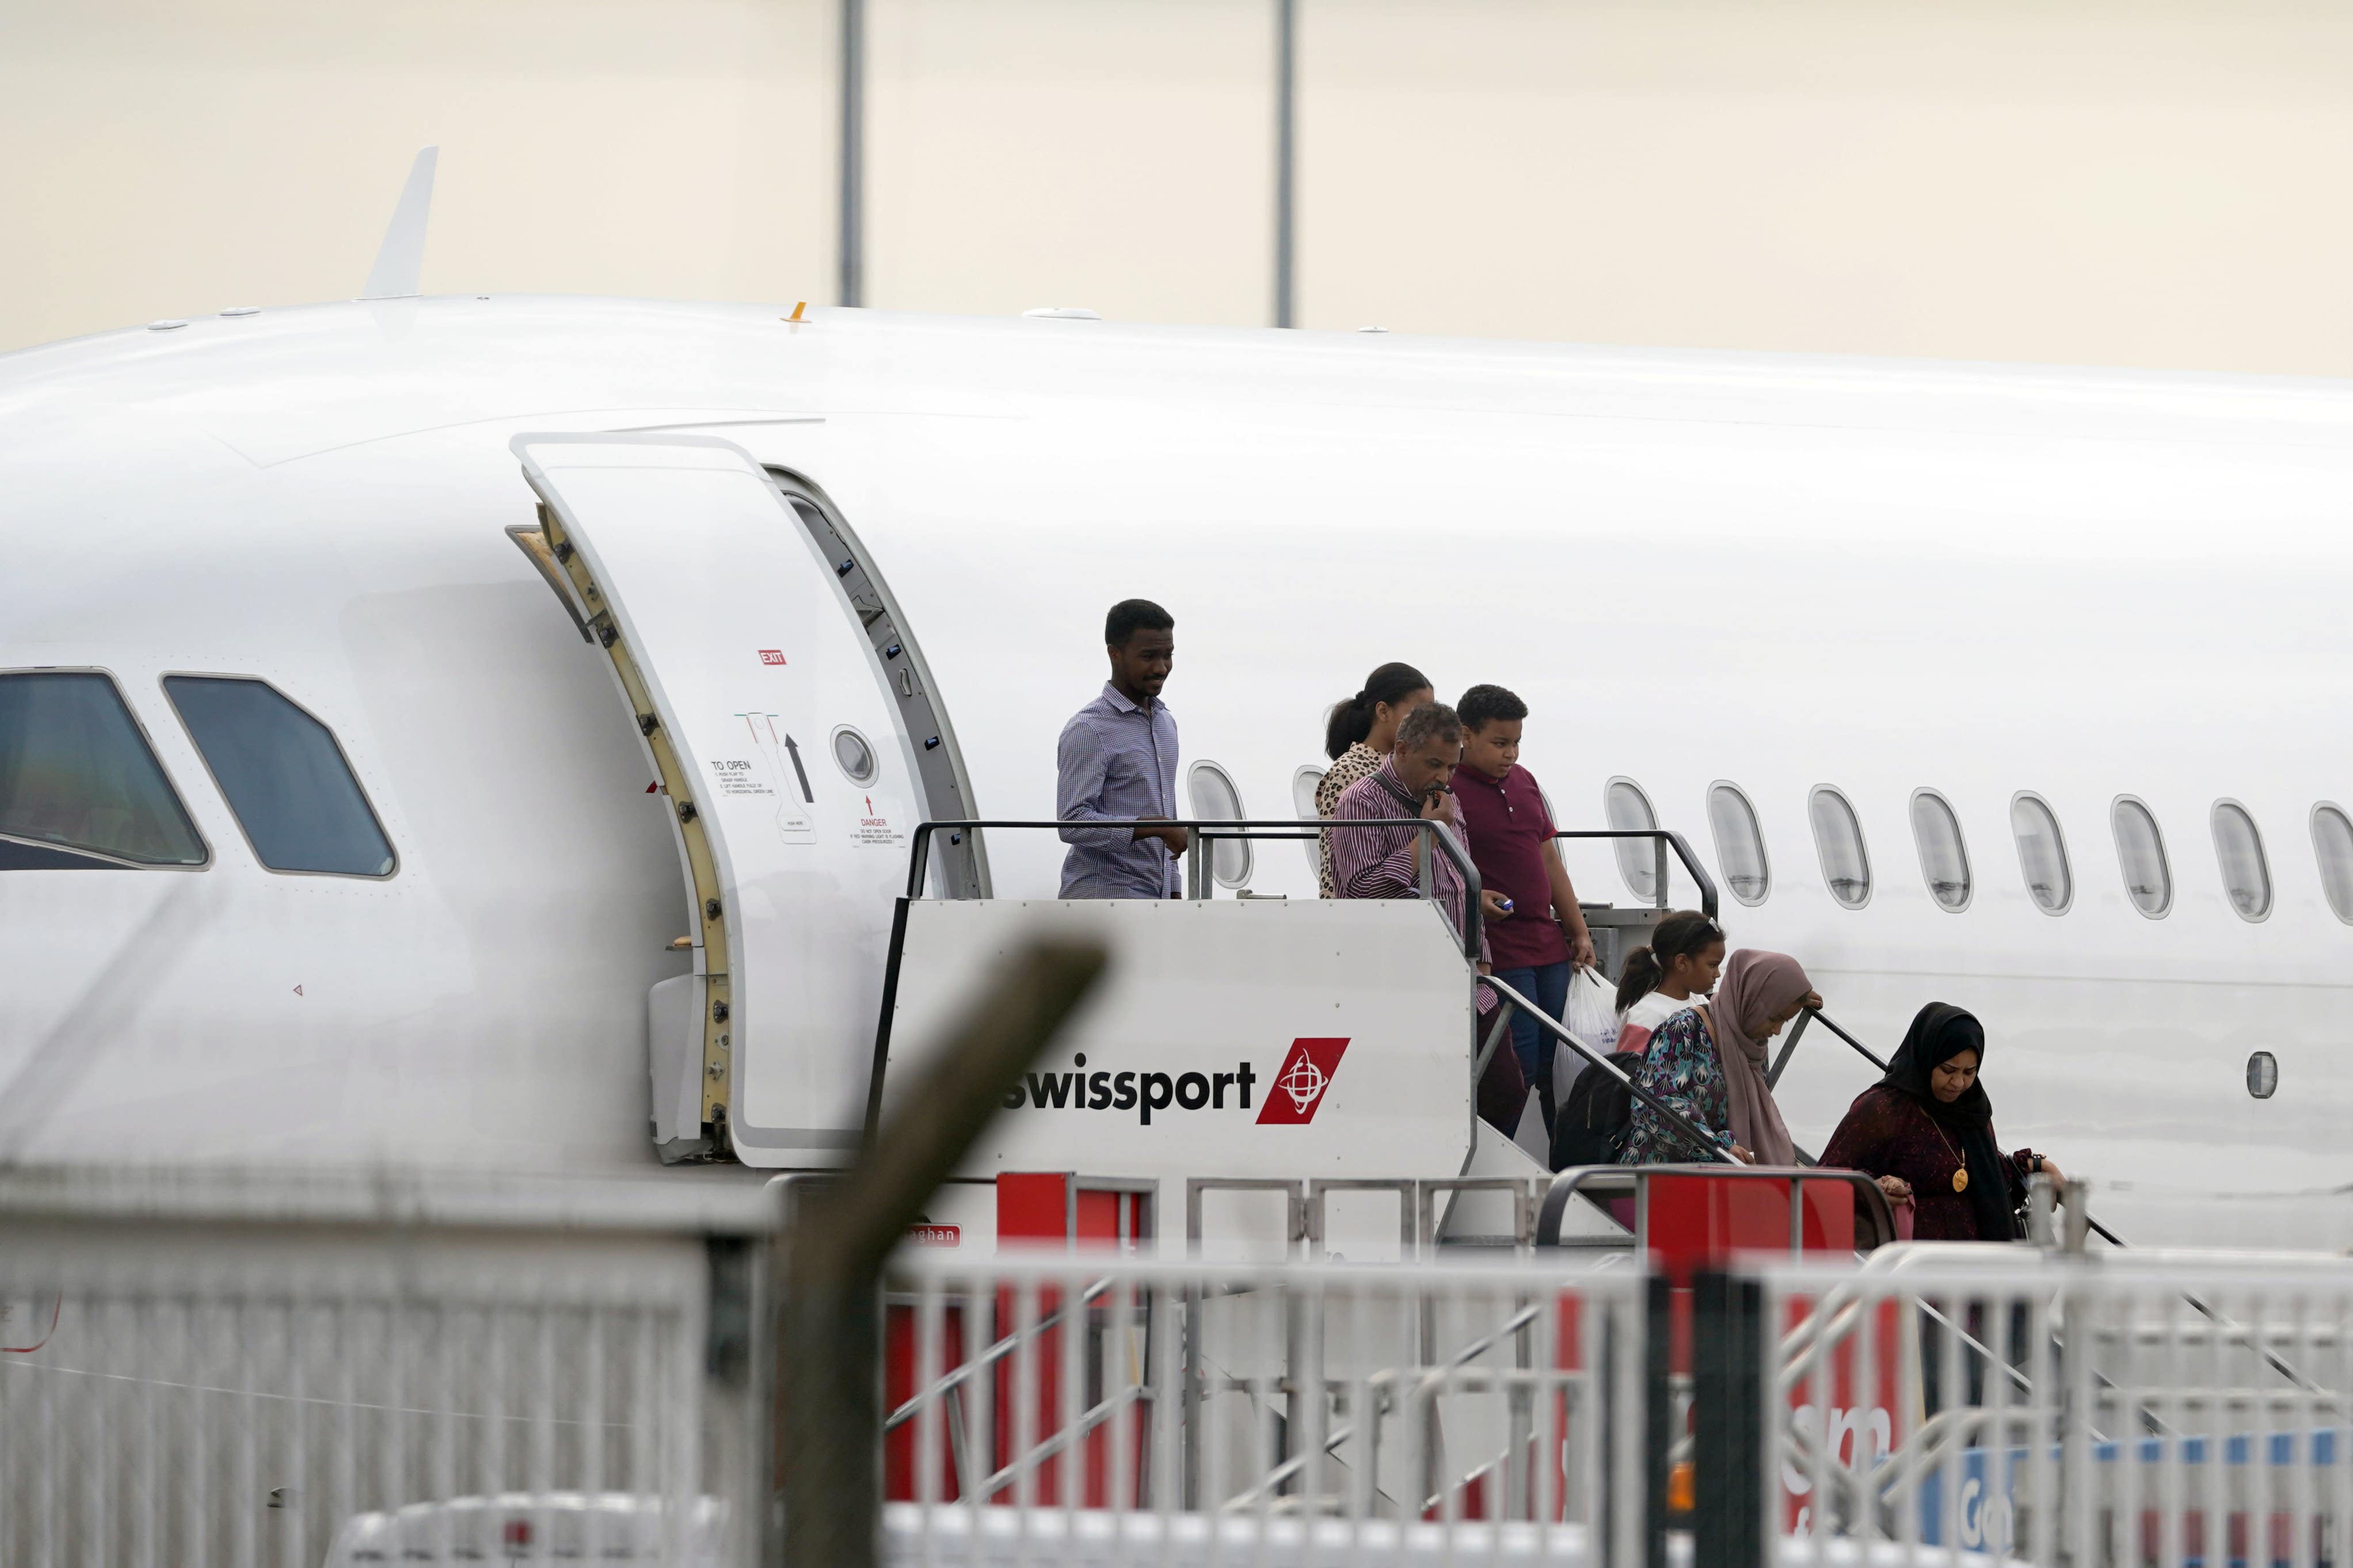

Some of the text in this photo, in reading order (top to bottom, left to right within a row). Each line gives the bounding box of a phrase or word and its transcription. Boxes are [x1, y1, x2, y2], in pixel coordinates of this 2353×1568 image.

[760, 652, 783, 662] EXIT
[711, 761, 751, 770] TO OPEN
[911, 1227, 954, 1243] aghan
